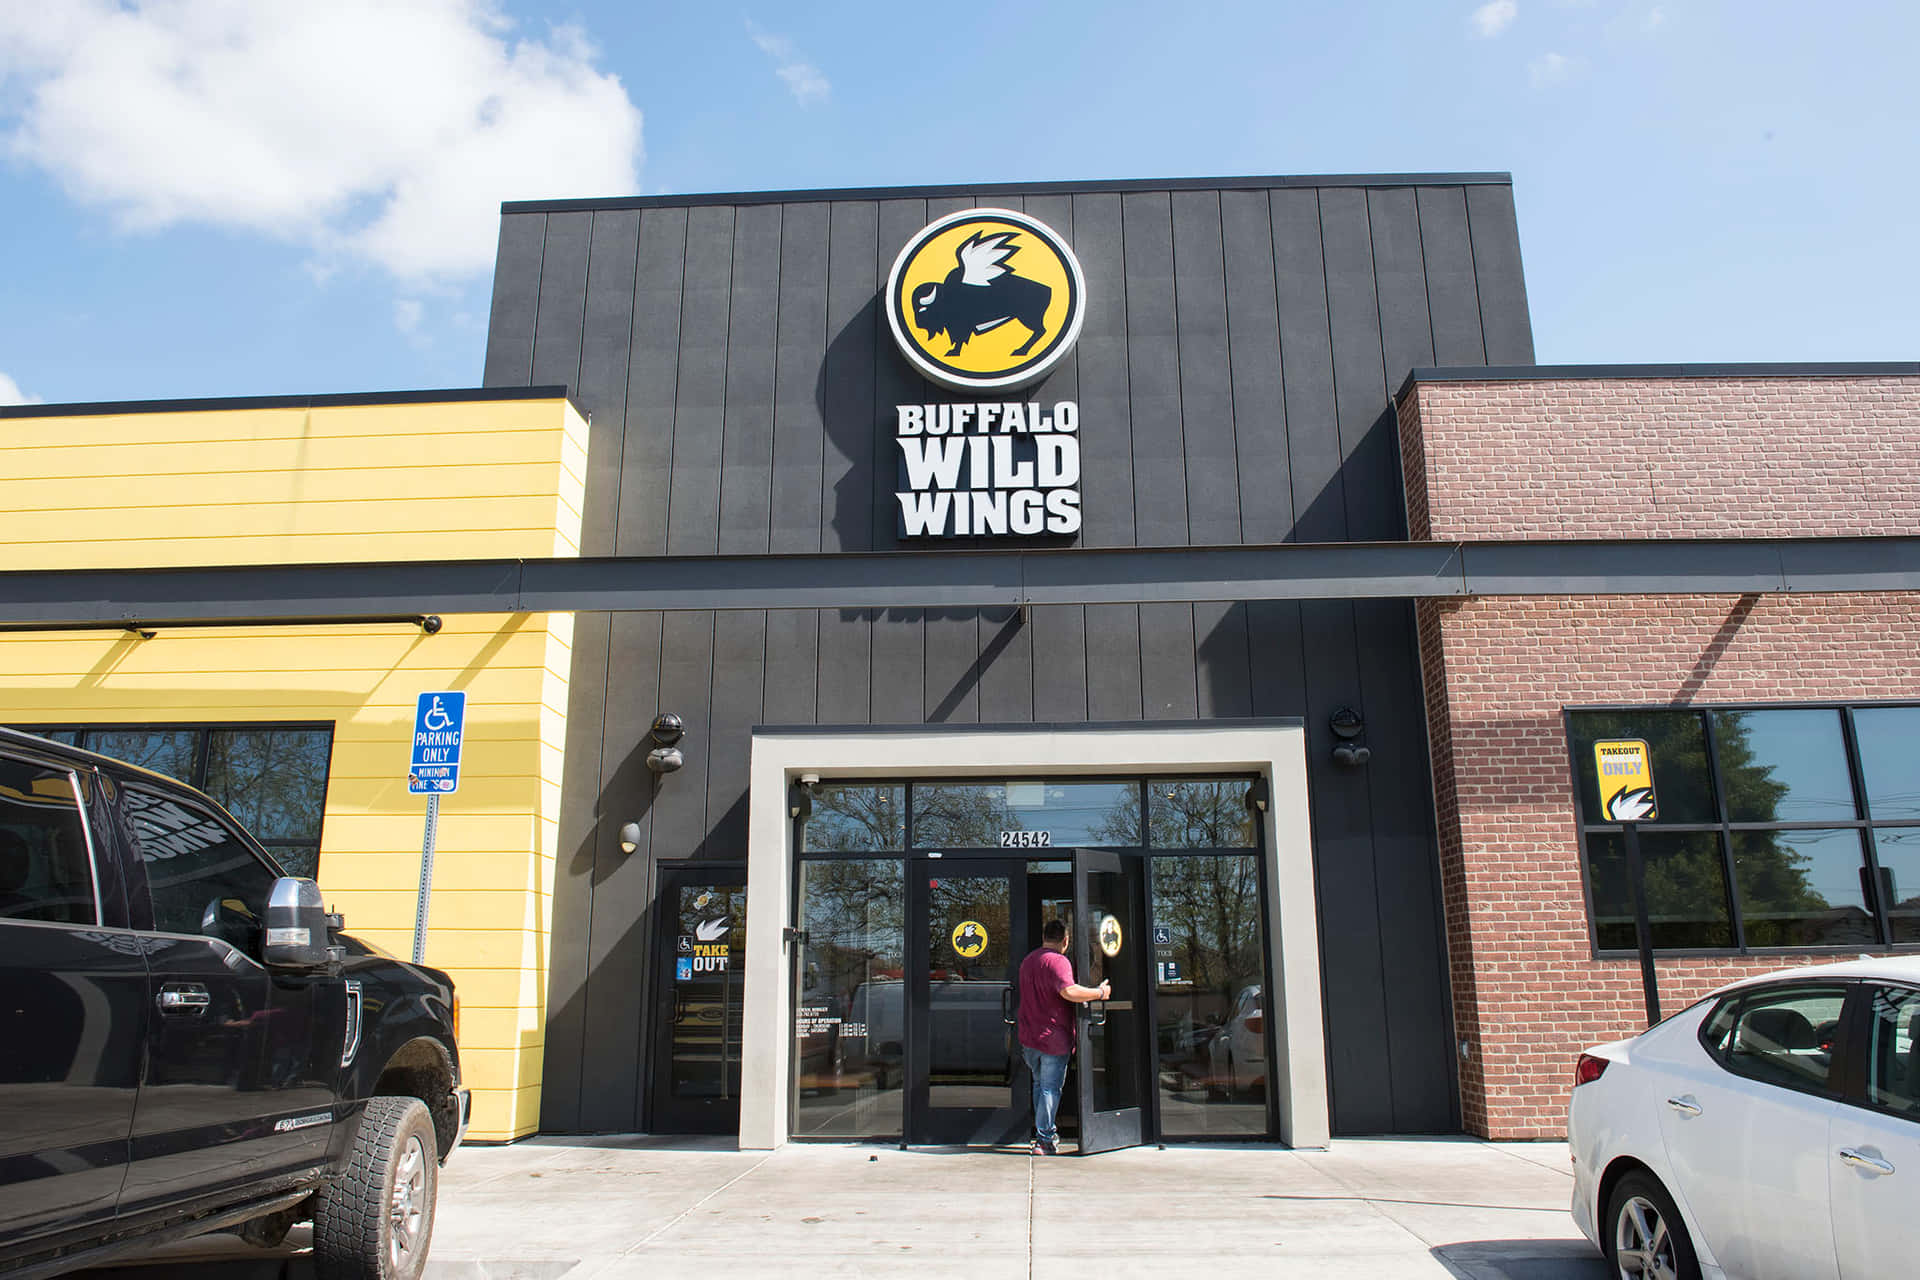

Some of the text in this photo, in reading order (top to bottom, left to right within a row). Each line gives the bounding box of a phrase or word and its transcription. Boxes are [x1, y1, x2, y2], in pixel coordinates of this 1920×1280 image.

[895, 401, 1079, 436] BUFFALO
[895, 434, 1080, 490] WILD
[895, 489, 1082, 536] WINGS
[416, 731, 460, 746] PARKING
[423, 747, 450, 762] ONLY
[1600, 747, 1640, 755] TAKEOUT
[1603, 762, 1642, 776] ONLY
[1002, 831, 1049, 848] 24542
[693, 944, 728, 957] TAKE
[693, 956, 728, 971] OUT
